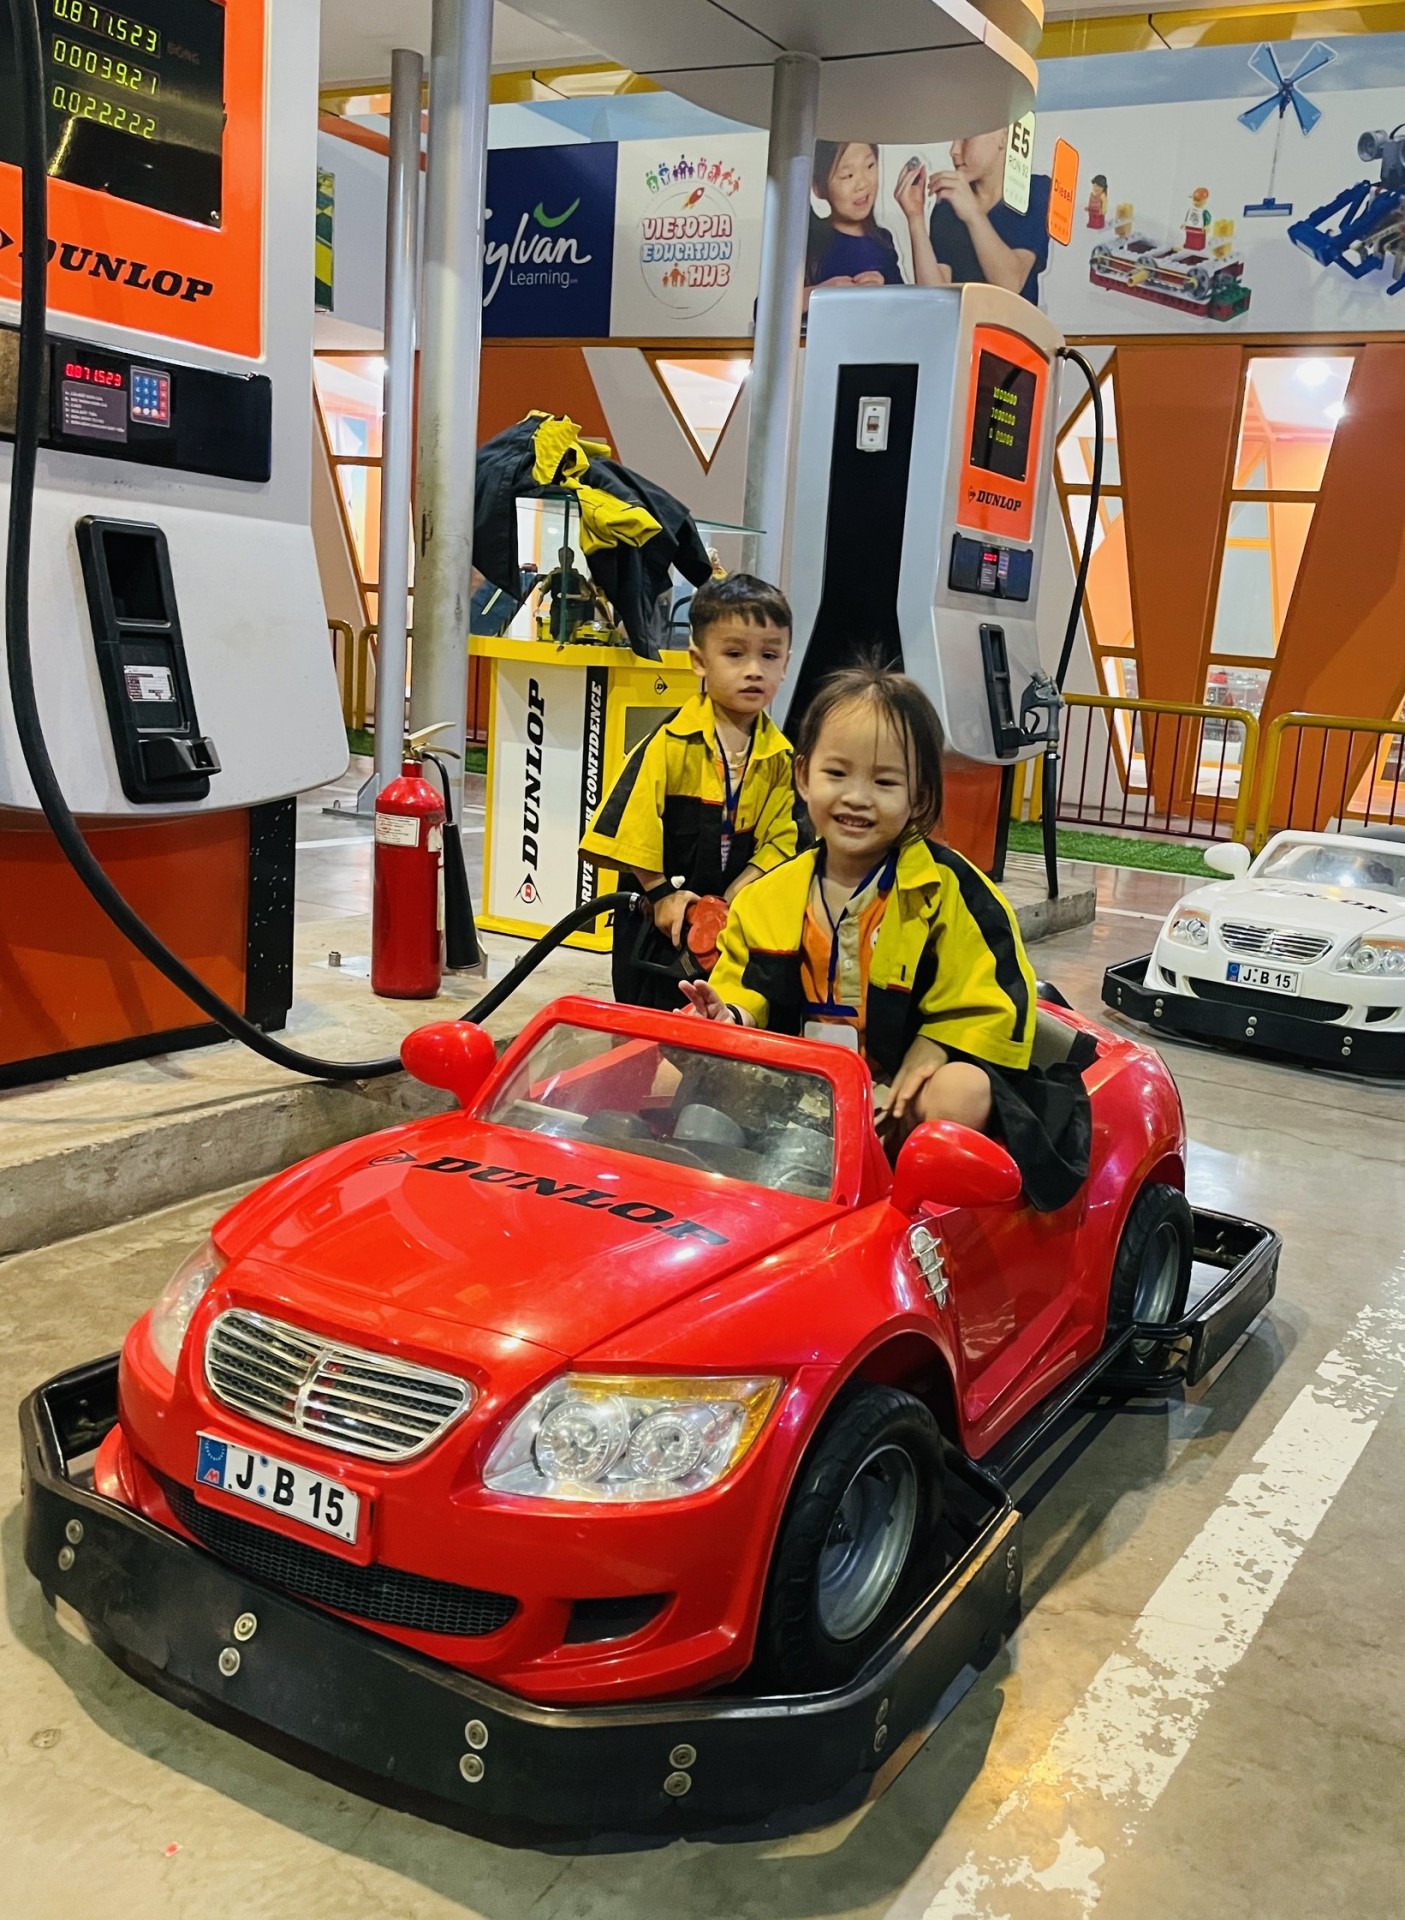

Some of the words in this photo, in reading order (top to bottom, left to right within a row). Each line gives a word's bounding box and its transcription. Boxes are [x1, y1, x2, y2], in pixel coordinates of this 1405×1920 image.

[53, 40, 156, 95] 00039.21
[52, 86, 155, 139] 0.022.222
[1011, 121, 1030, 159] E5
[1053, 179, 1073, 204] Diesel
[641, 214, 732, 240] VIETOPIA
[484, 208, 592, 307] ylvan
[641, 241, 732, 263] EDUCATION
[510, 270, 570, 288] Learning
[687, 263, 731, 287] HUB
[976, 490, 1022, 512] DUNLOP
[585, 682, 602, 807] CONFIDENCE
[522, 678, 545, 871] DUNLOP
[1275, 974, 1291, 988] 15
[414, 1156, 730, 1246] DUNLOP
[309, 1482, 344, 1527] 15
